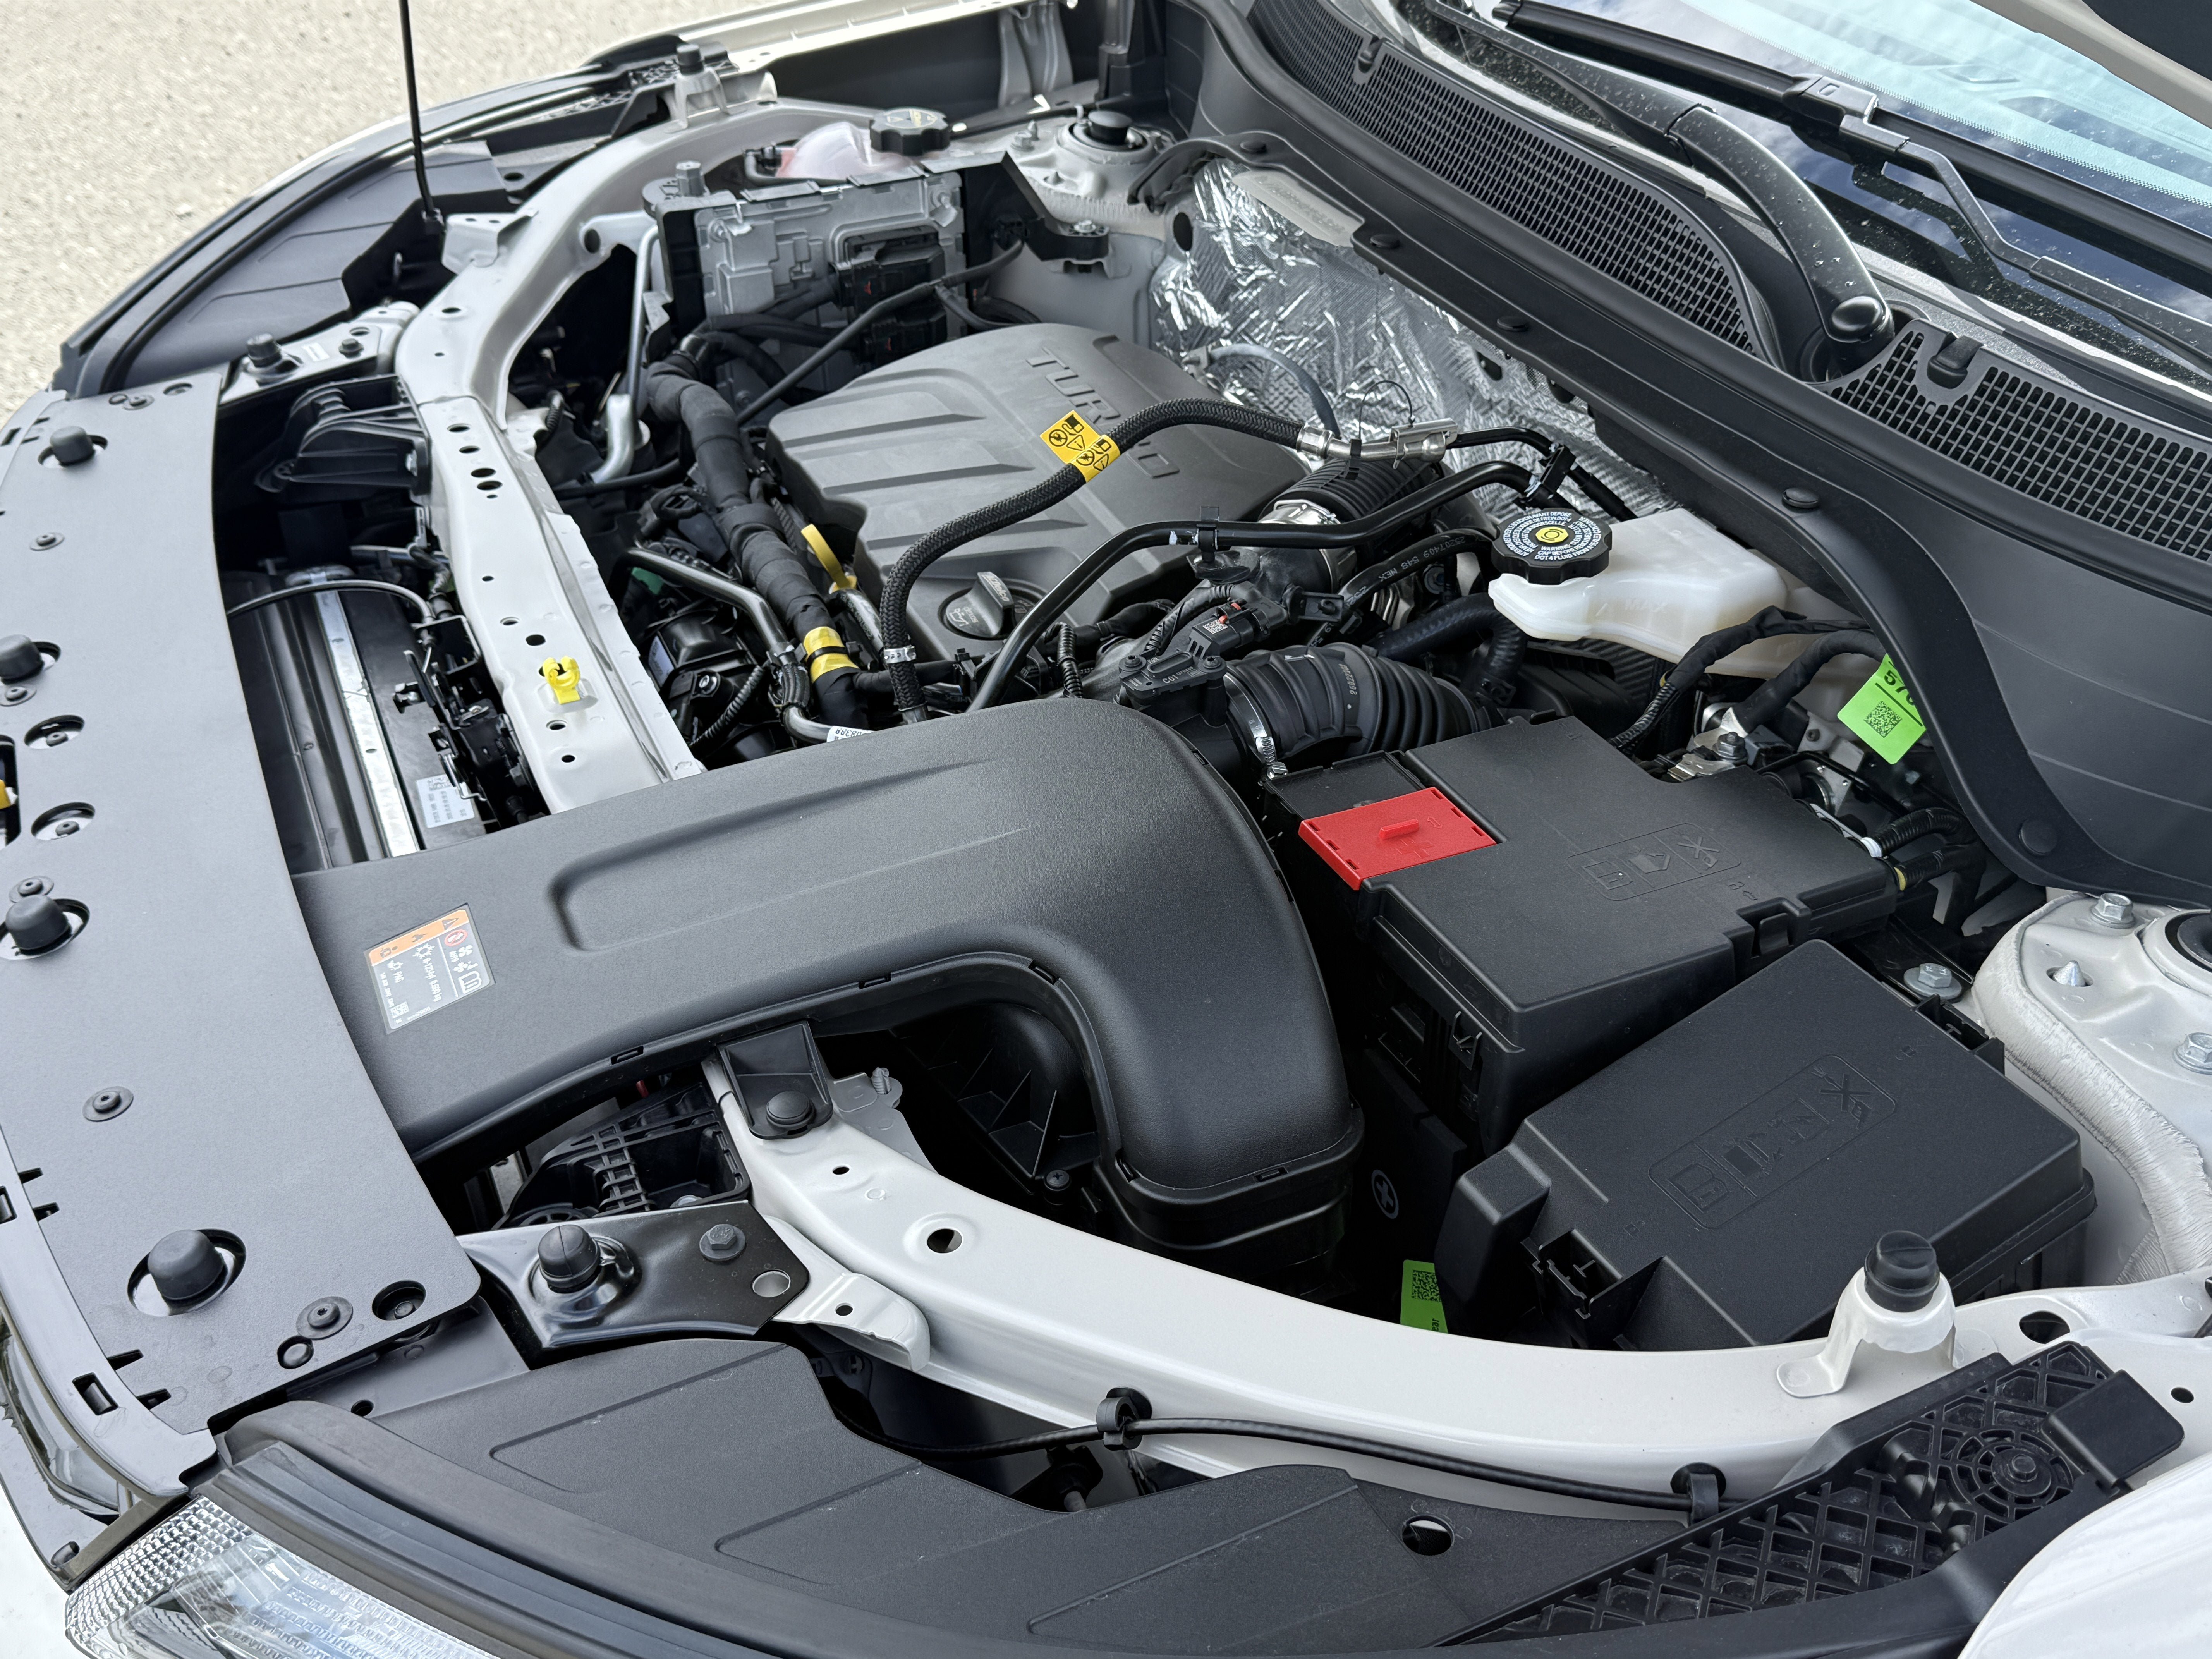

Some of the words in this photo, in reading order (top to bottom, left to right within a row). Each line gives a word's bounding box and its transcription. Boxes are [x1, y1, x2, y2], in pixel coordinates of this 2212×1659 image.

[1026, 346, 1180, 479] TURO
[1423, 536, 1465, 558] 25207409
[1572, 548, 1590, 556] FROM
[1589, 534, 1601, 546] SEALED
[1401, 556, 1419, 570] 548
[1162, 674, 1179, 684] C01
[449, 951, 459, 962] AUTO
[393, 971, 404, 983] PAG
